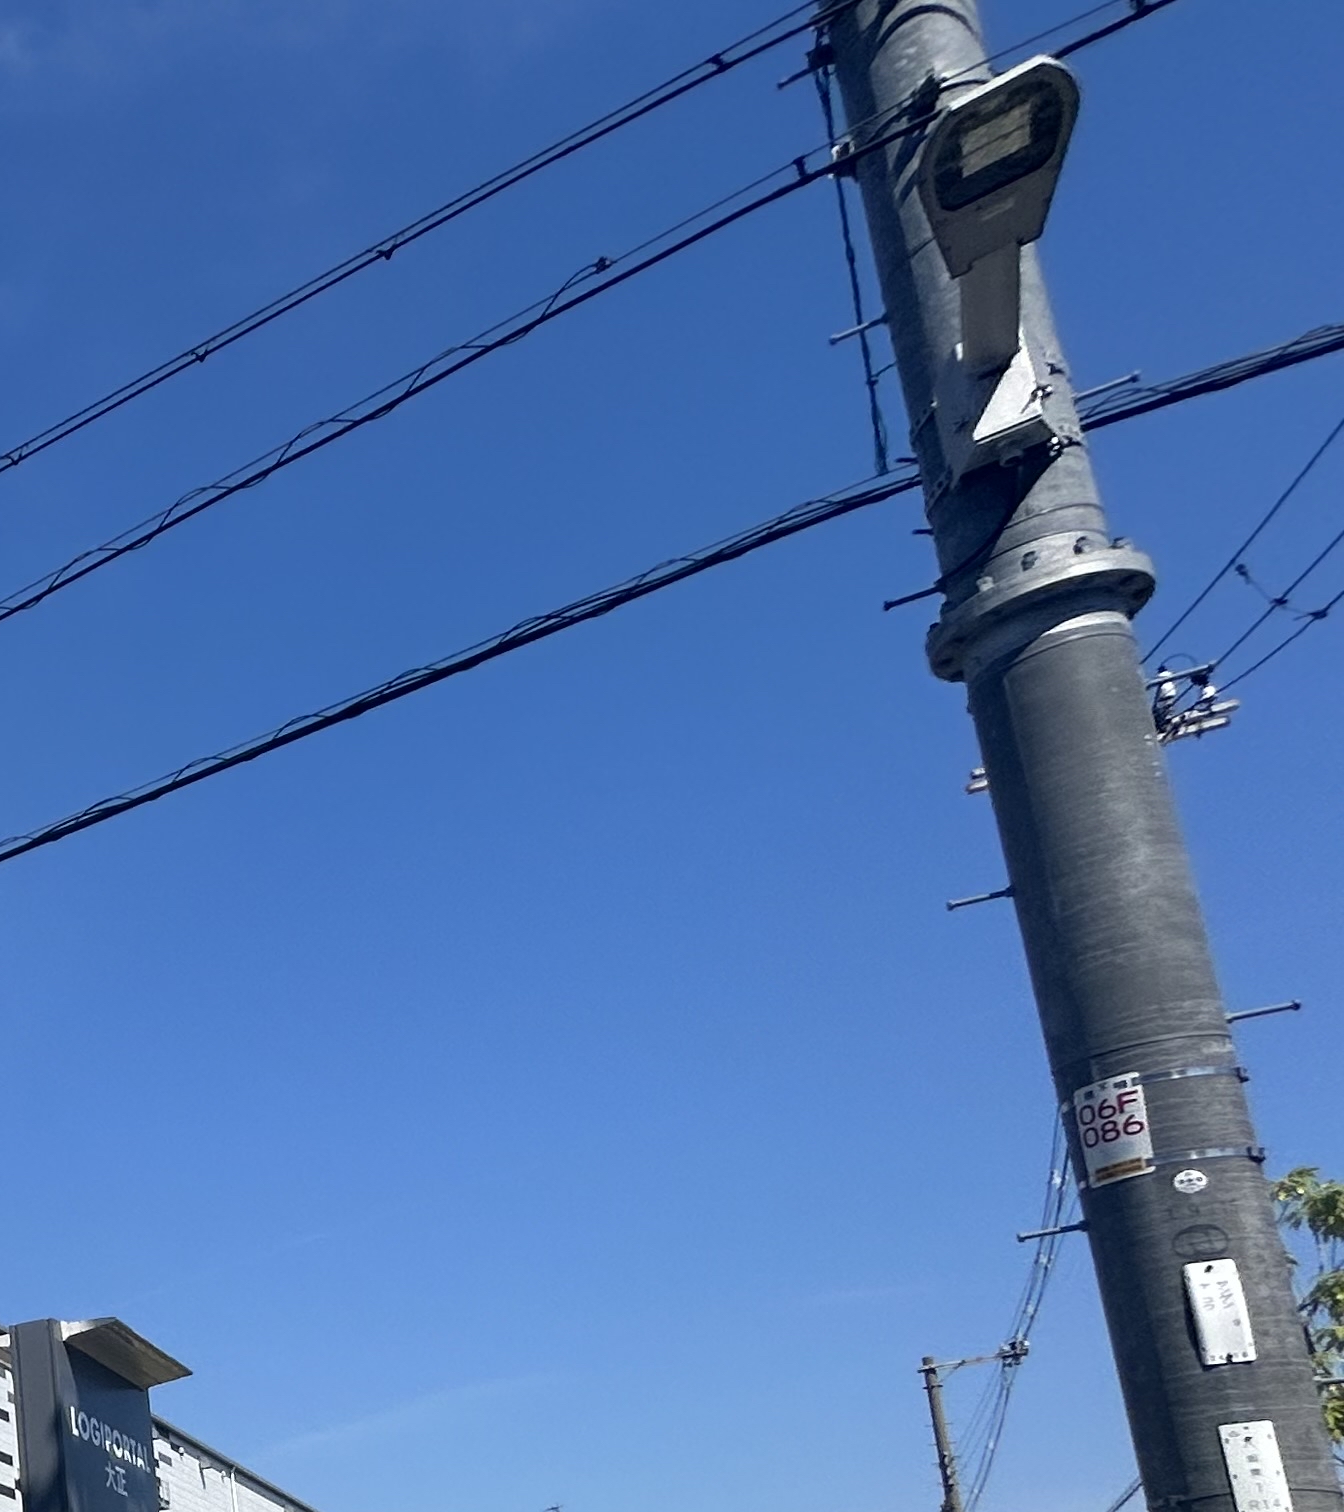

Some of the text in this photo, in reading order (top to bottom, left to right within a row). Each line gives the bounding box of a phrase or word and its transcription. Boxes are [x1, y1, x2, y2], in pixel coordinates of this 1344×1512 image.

[1078, 1088, 1139, 1126] 06F
[1082, 1114, 1145, 1149] 086
[70, 1406, 151, 1474] LOGIPORTAL
[105, 1461, 129, 1497] 大正
